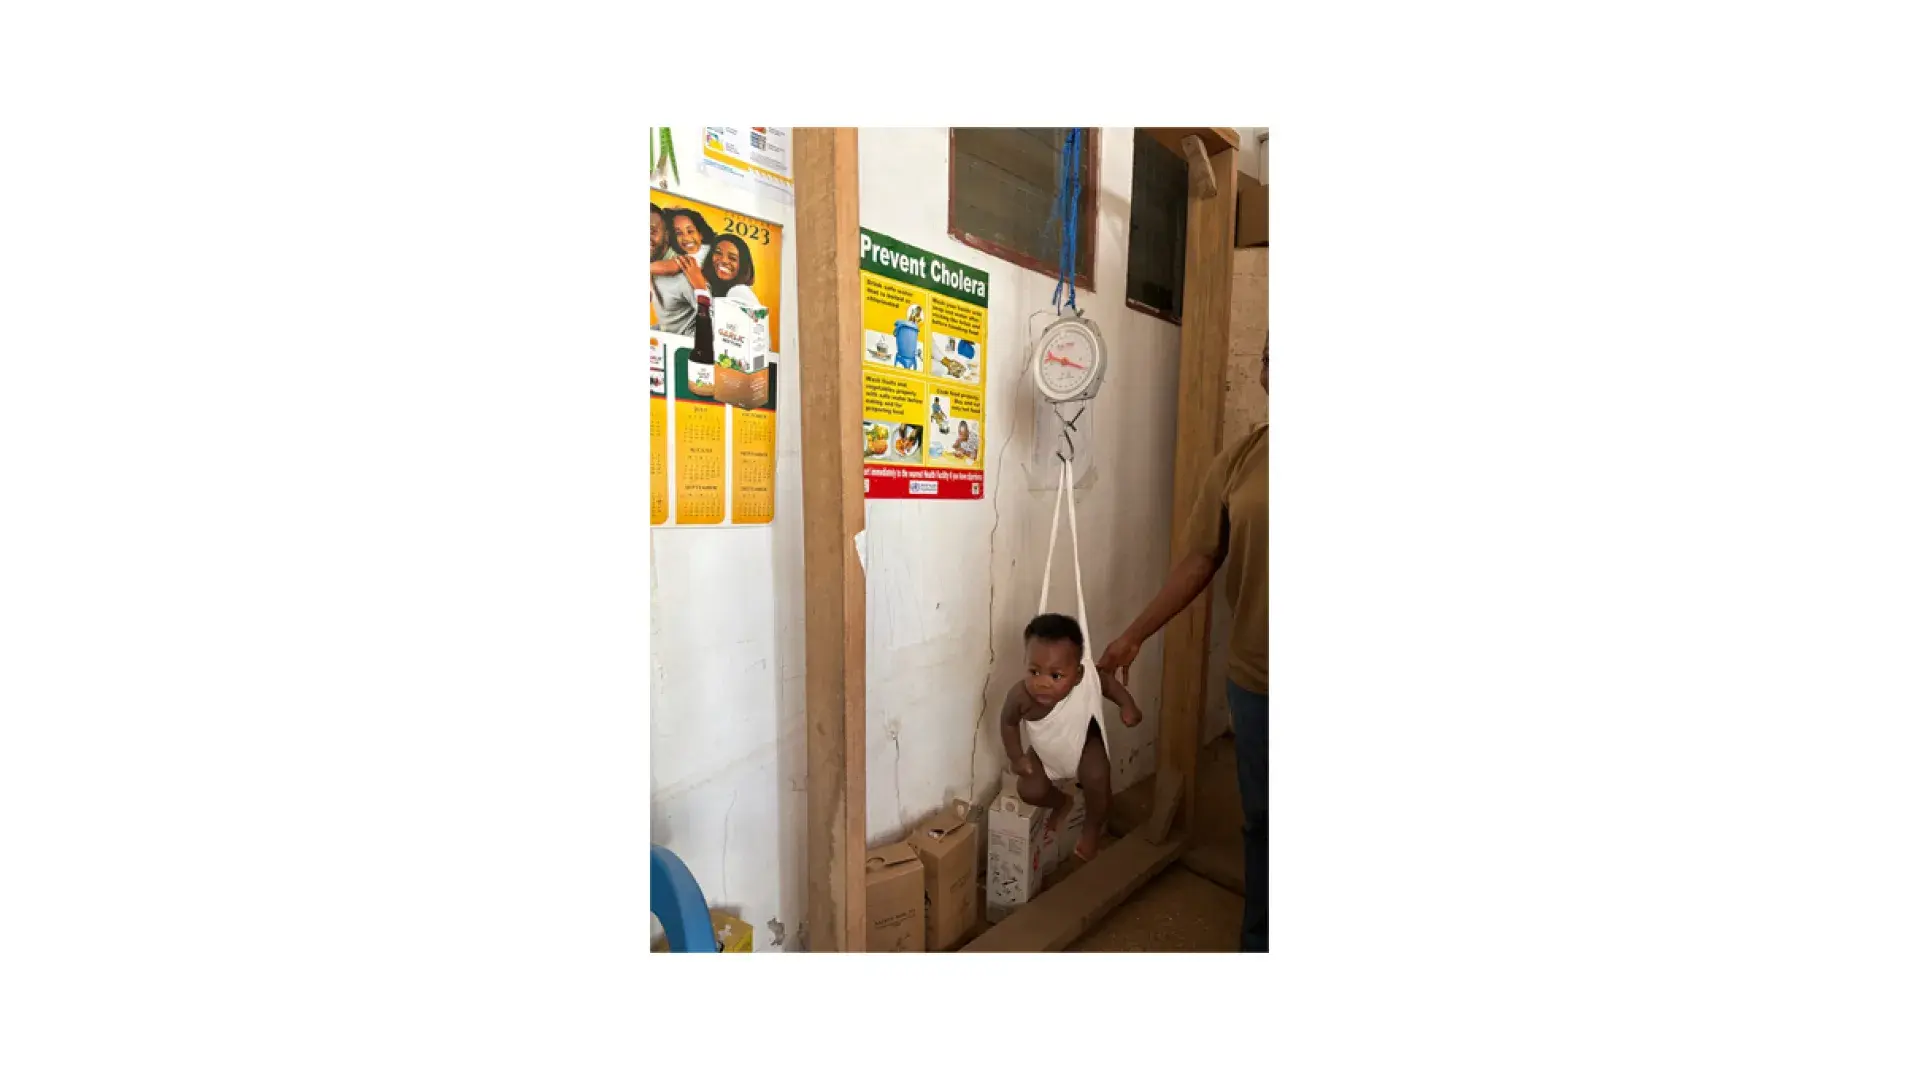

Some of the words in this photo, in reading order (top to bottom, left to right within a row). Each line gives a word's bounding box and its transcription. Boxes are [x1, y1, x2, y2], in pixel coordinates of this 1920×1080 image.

[724, 217, 770, 245] 2023
[861, 233, 926, 279] Prevent
[930, 259, 986, 298] Cholera
